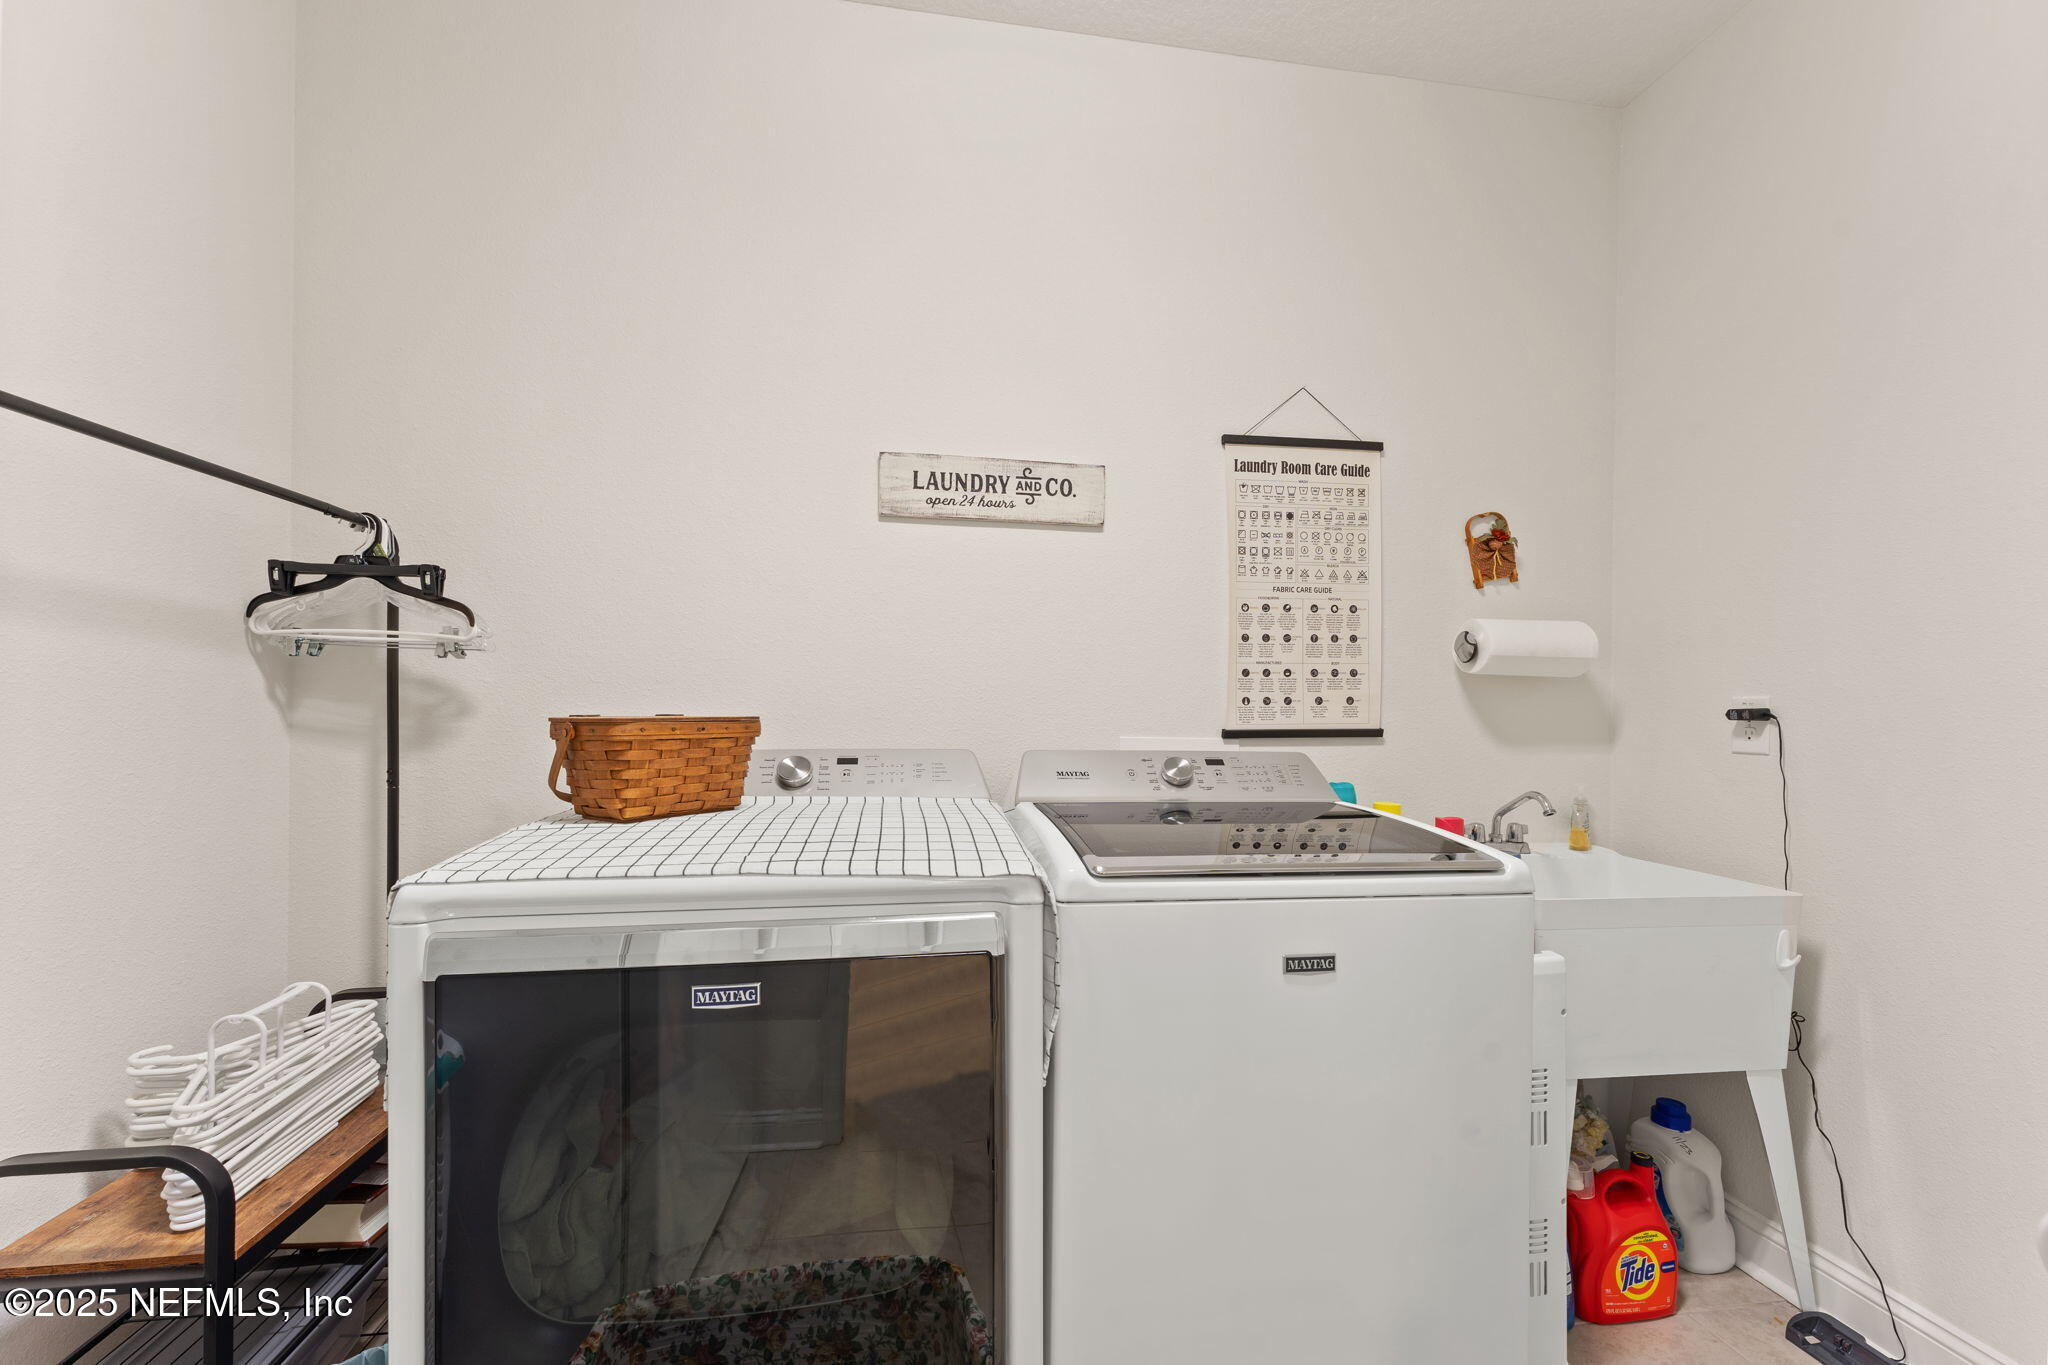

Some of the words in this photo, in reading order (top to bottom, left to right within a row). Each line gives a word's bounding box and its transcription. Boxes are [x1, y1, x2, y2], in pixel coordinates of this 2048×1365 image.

[1234, 458, 1278, 475] Laundry
[1281, 460, 1311, 475] Room
[1315, 462, 1337, 476] Care
[1341, 463, 1371, 477] Guide
[912, 470, 1011, 494] LAUNDRY
[1015, 479, 1042, 492] AND
[1045, 477, 1077, 498] CO.
[925, 495, 957, 508] open
[959, 494, 975, 507] 24
[977, 495, 1016, 509] hours
[1287, 958, 1334, 970] MAYTAG
[695, 989, 757, 1004] MAYTAG
[1619, 1256, 1656, 1293] Tide
